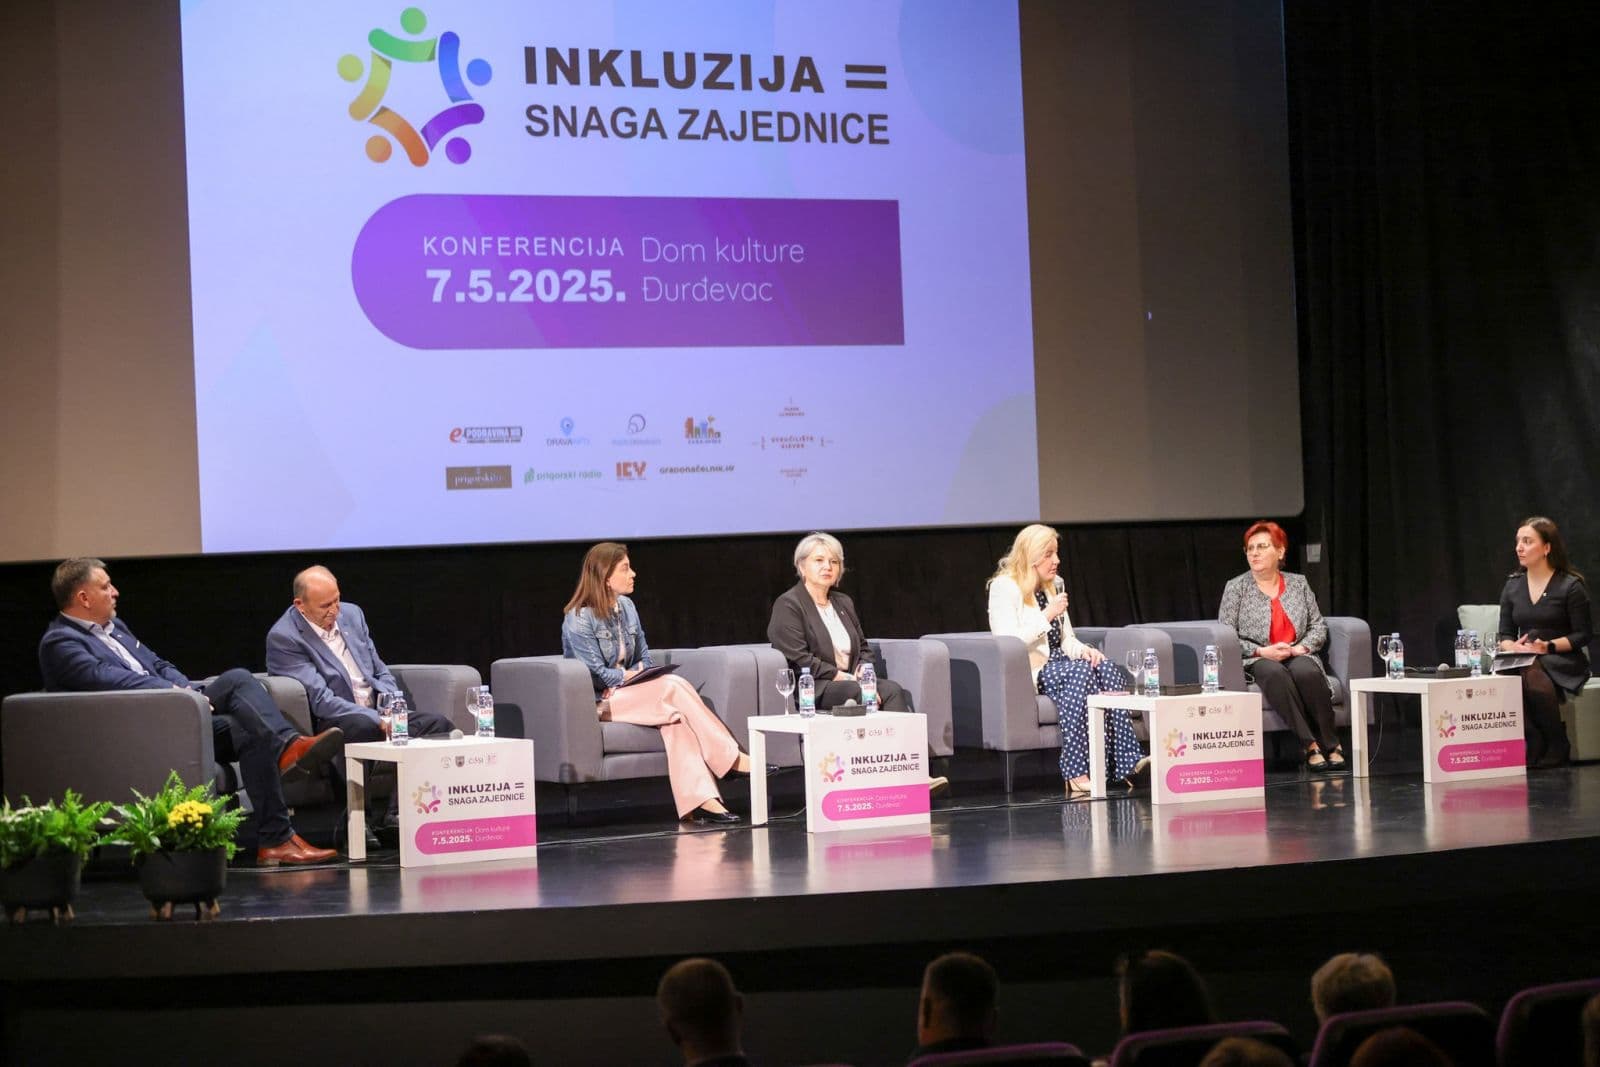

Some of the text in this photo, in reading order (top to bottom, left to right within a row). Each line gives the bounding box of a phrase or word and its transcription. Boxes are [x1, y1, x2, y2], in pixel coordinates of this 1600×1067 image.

[523, 45, 888, 94] INKLUZIJA =
[524, 103, 891, 145] SNAGA ZAJEDNICE
[423, 236, 805, 264] KONFERENCIJA Dom kulture
[425, 269, 773, 304] 7.5.2025. Đurđevac
[536, 470, 602, 481] prigorski radio
[1461, 711, 1507, 722] INKLUZIJA
[1461, 721, 1517, 732] SNAGA ZAJEDNICE
[1192, 730, 1244, 741] INKLUZIJA
[1192, 740, 1255, 751] SNAGA ZAJEDNICE
[850, 753, 907, 765] INKLUZIJA
[850, 763, 920, 775] SNAGA ZAJEDNICE
[1179, 776, 1214, 785] 7.5.2025.
[448, 781, 511, 795] INKLUZIJA
[448, 793, 525, 806] SNAGA ZAJEDNICE
[836, 802, 874, 813] 7.5.2025.
[432, 836, 473, 846] 7.5.2025.
